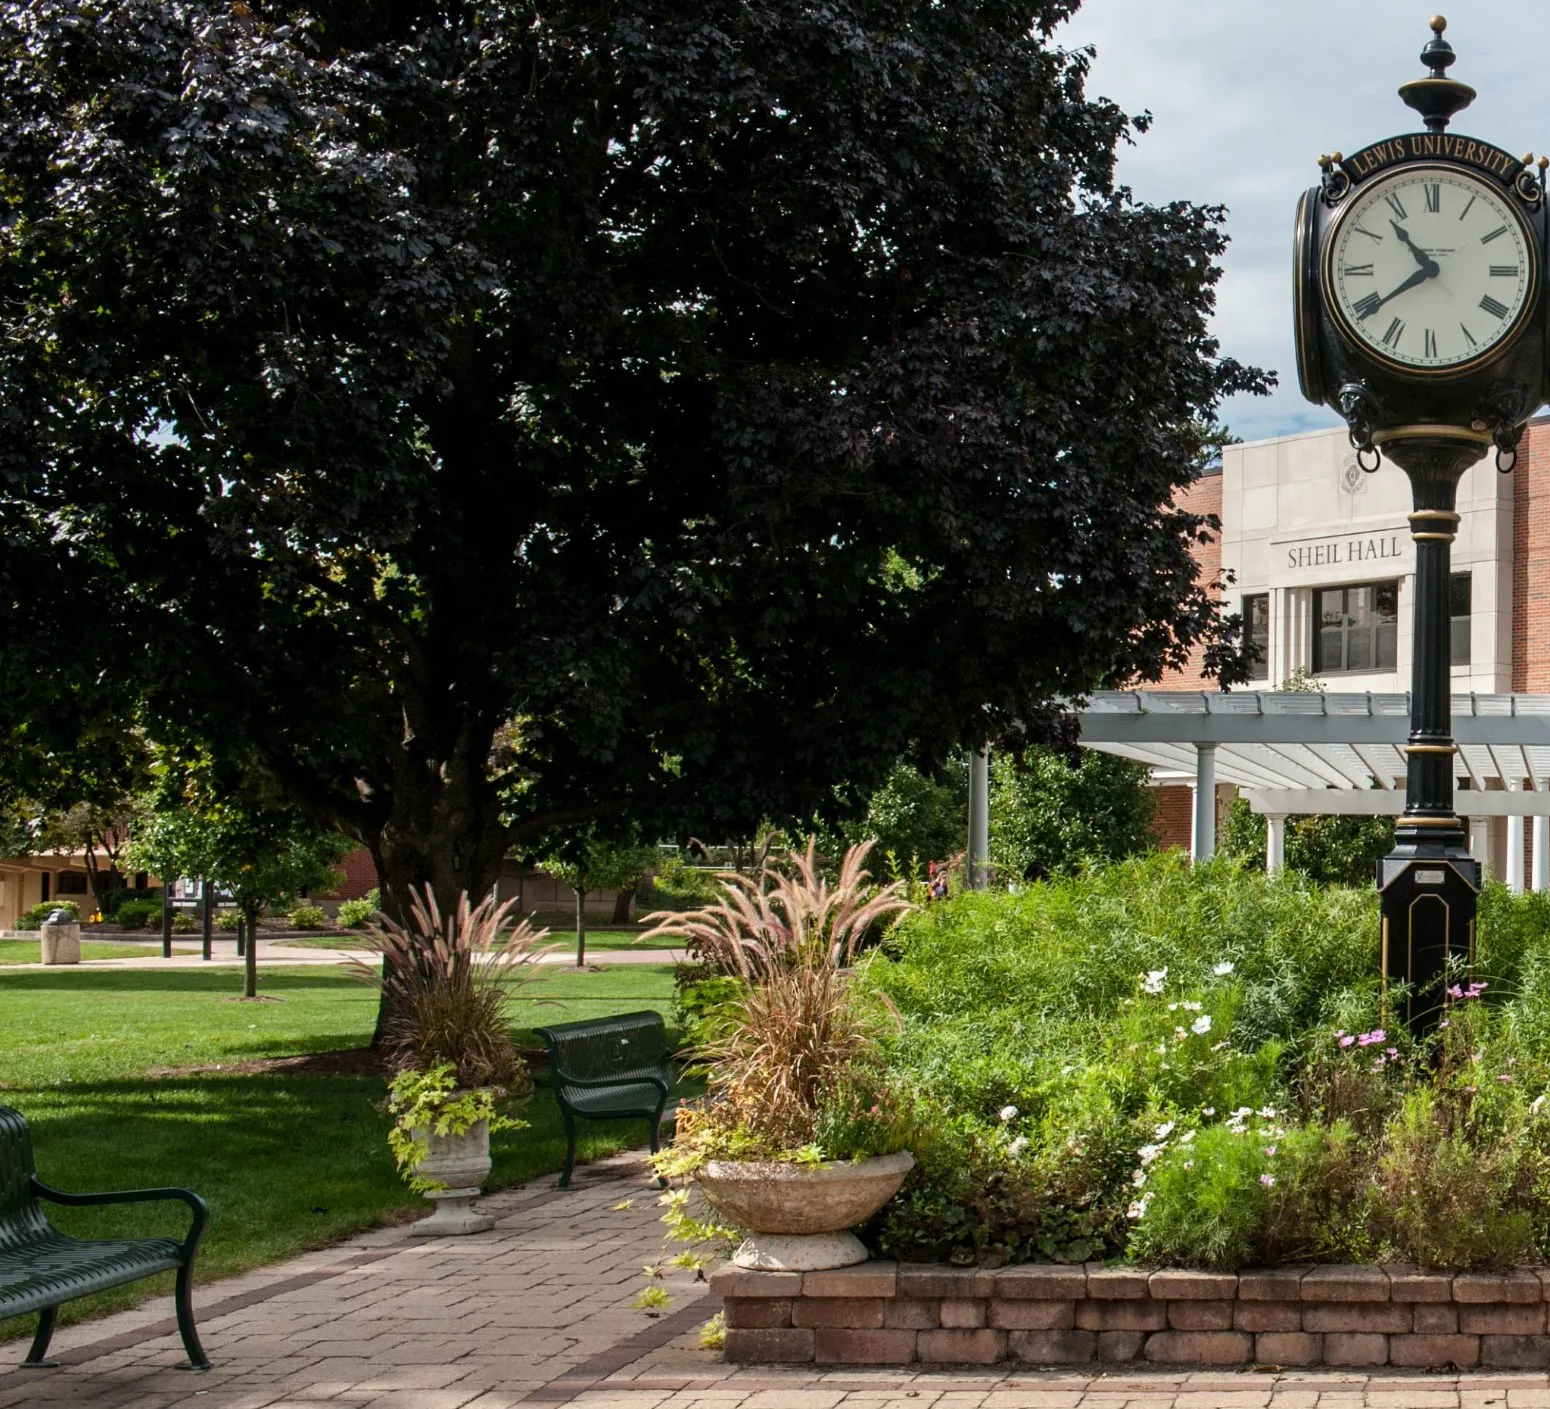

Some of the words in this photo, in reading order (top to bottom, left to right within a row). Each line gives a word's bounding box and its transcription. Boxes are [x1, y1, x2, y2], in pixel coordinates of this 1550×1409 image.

[1353, 139, 1405, 174] LEWIS
[1411, 136, 1514, 174] UNIVERSITY
[1424, 184, 1440, 213] XII
[1288, 543, 1342, 568] SHEIL
[1348, 537, 1402, 561] HALL
